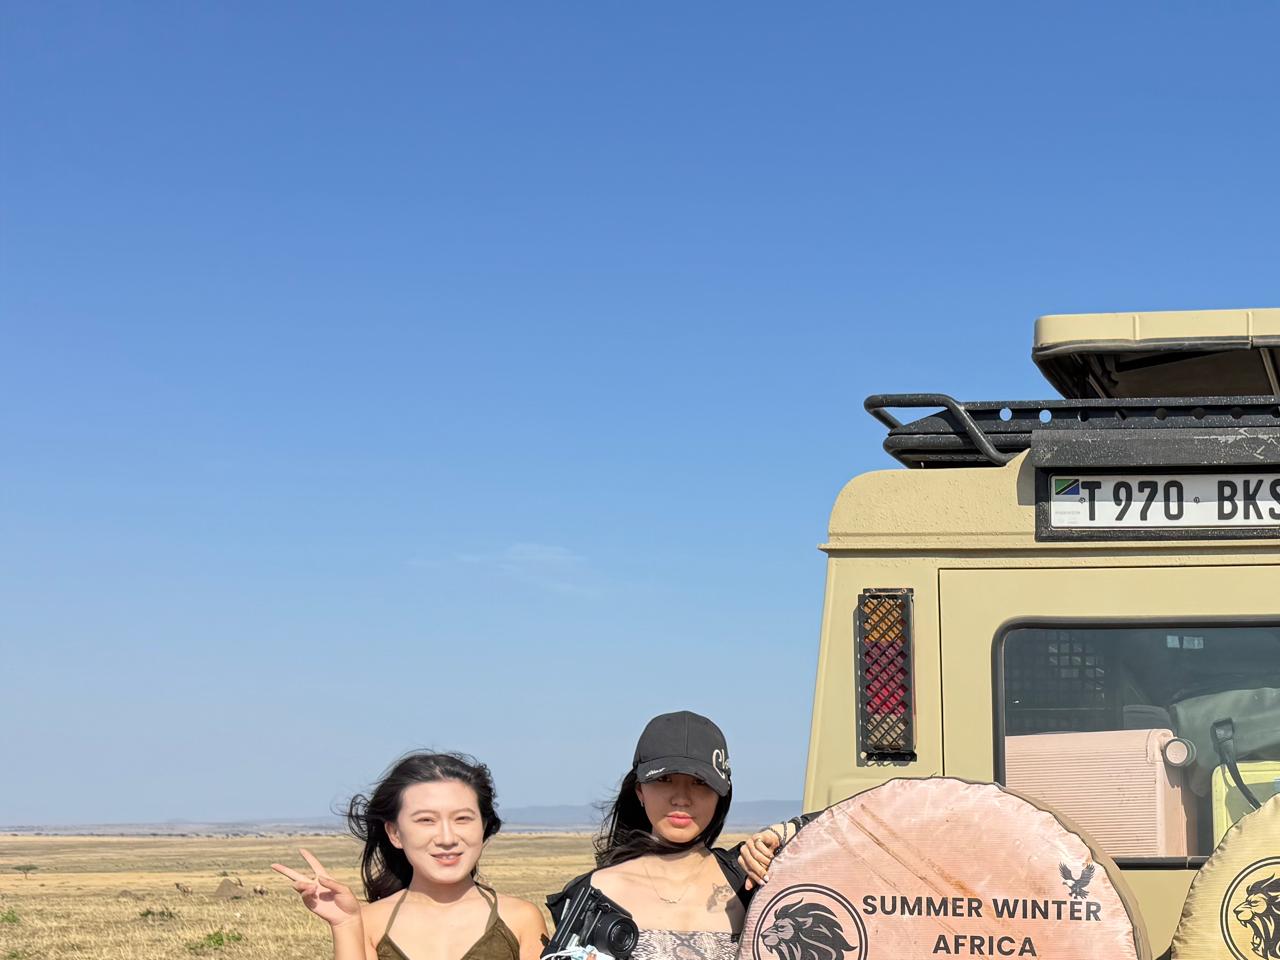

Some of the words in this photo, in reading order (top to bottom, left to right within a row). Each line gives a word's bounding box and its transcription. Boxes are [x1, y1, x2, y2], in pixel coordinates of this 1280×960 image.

[1081, 481, 1102, 521] T
[1112, 480, 1184, 522] 970
[862, 894, 984, 918] SUMMER
[992, 898, 1102, 922] WINTER
[932, 934, 1038, 957] AFRICA
